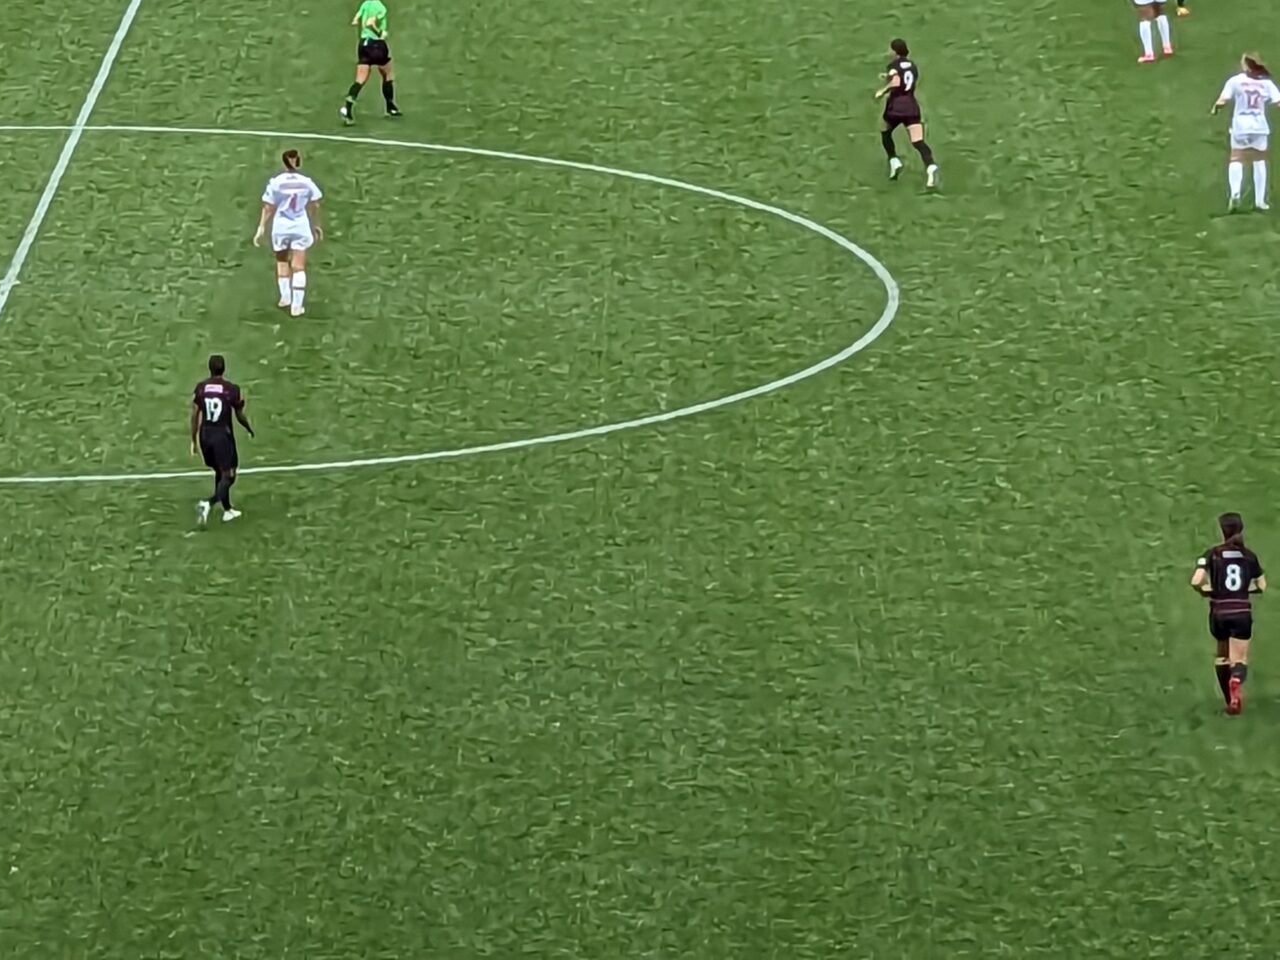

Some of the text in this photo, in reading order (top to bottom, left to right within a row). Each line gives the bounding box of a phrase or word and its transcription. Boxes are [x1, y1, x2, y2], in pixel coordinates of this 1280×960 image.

[903, 71, 914, 92] 9
[204, 397, 223, 422] 19
[1225, 564, 1242, 591] 8
